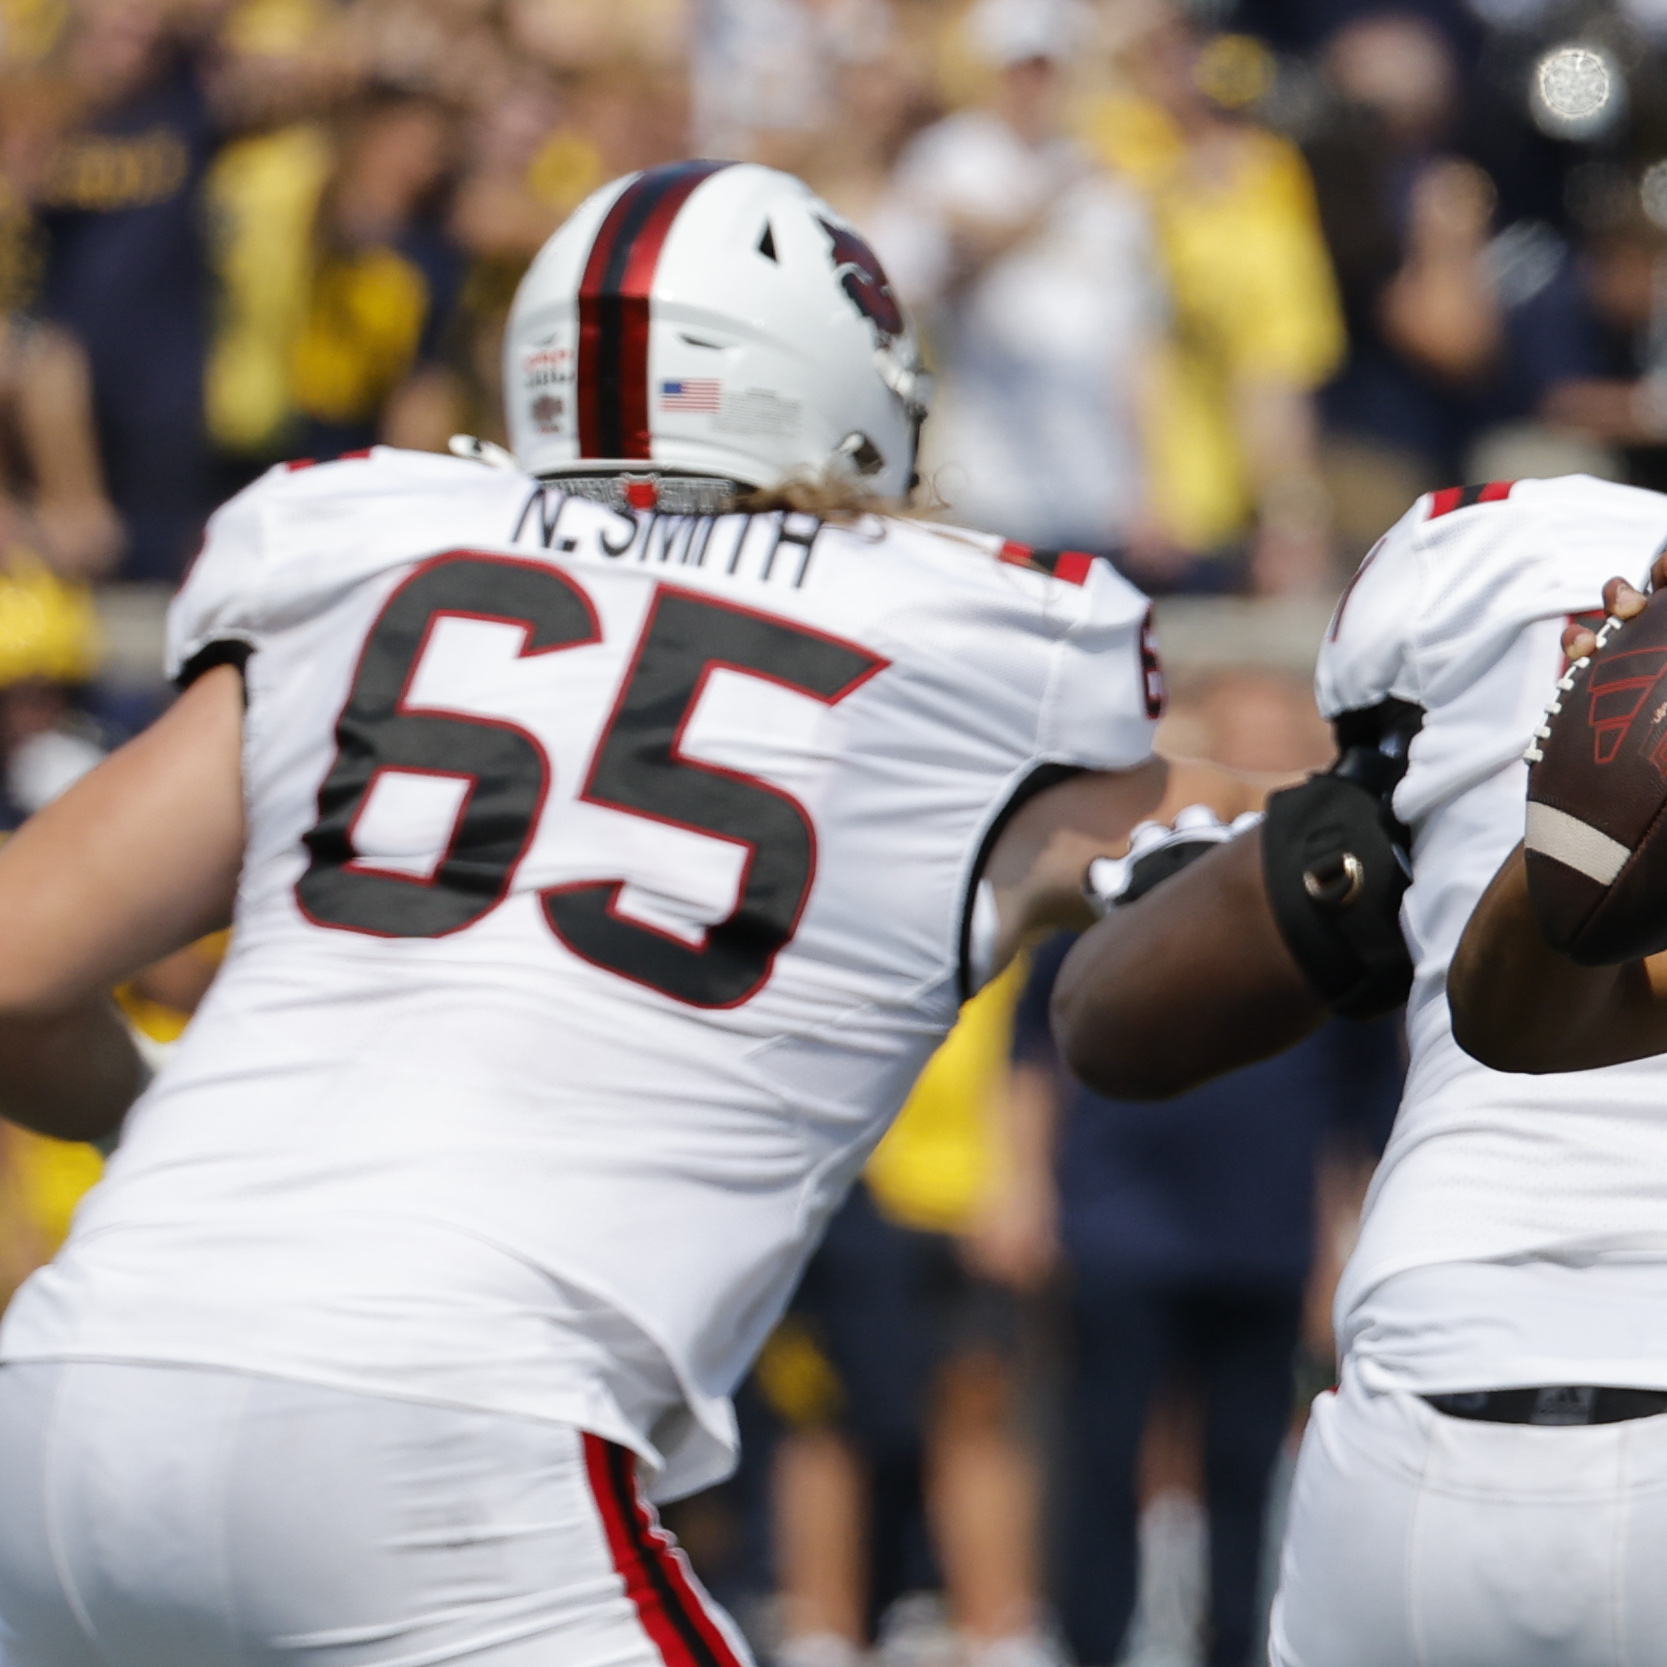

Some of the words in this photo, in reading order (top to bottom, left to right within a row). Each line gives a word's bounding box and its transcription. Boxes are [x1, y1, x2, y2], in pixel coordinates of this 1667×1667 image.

[511, 487, 577, 552] N.
[600, 506, 824, 588] SMITH
[294, 549, 894, 1011] 65
